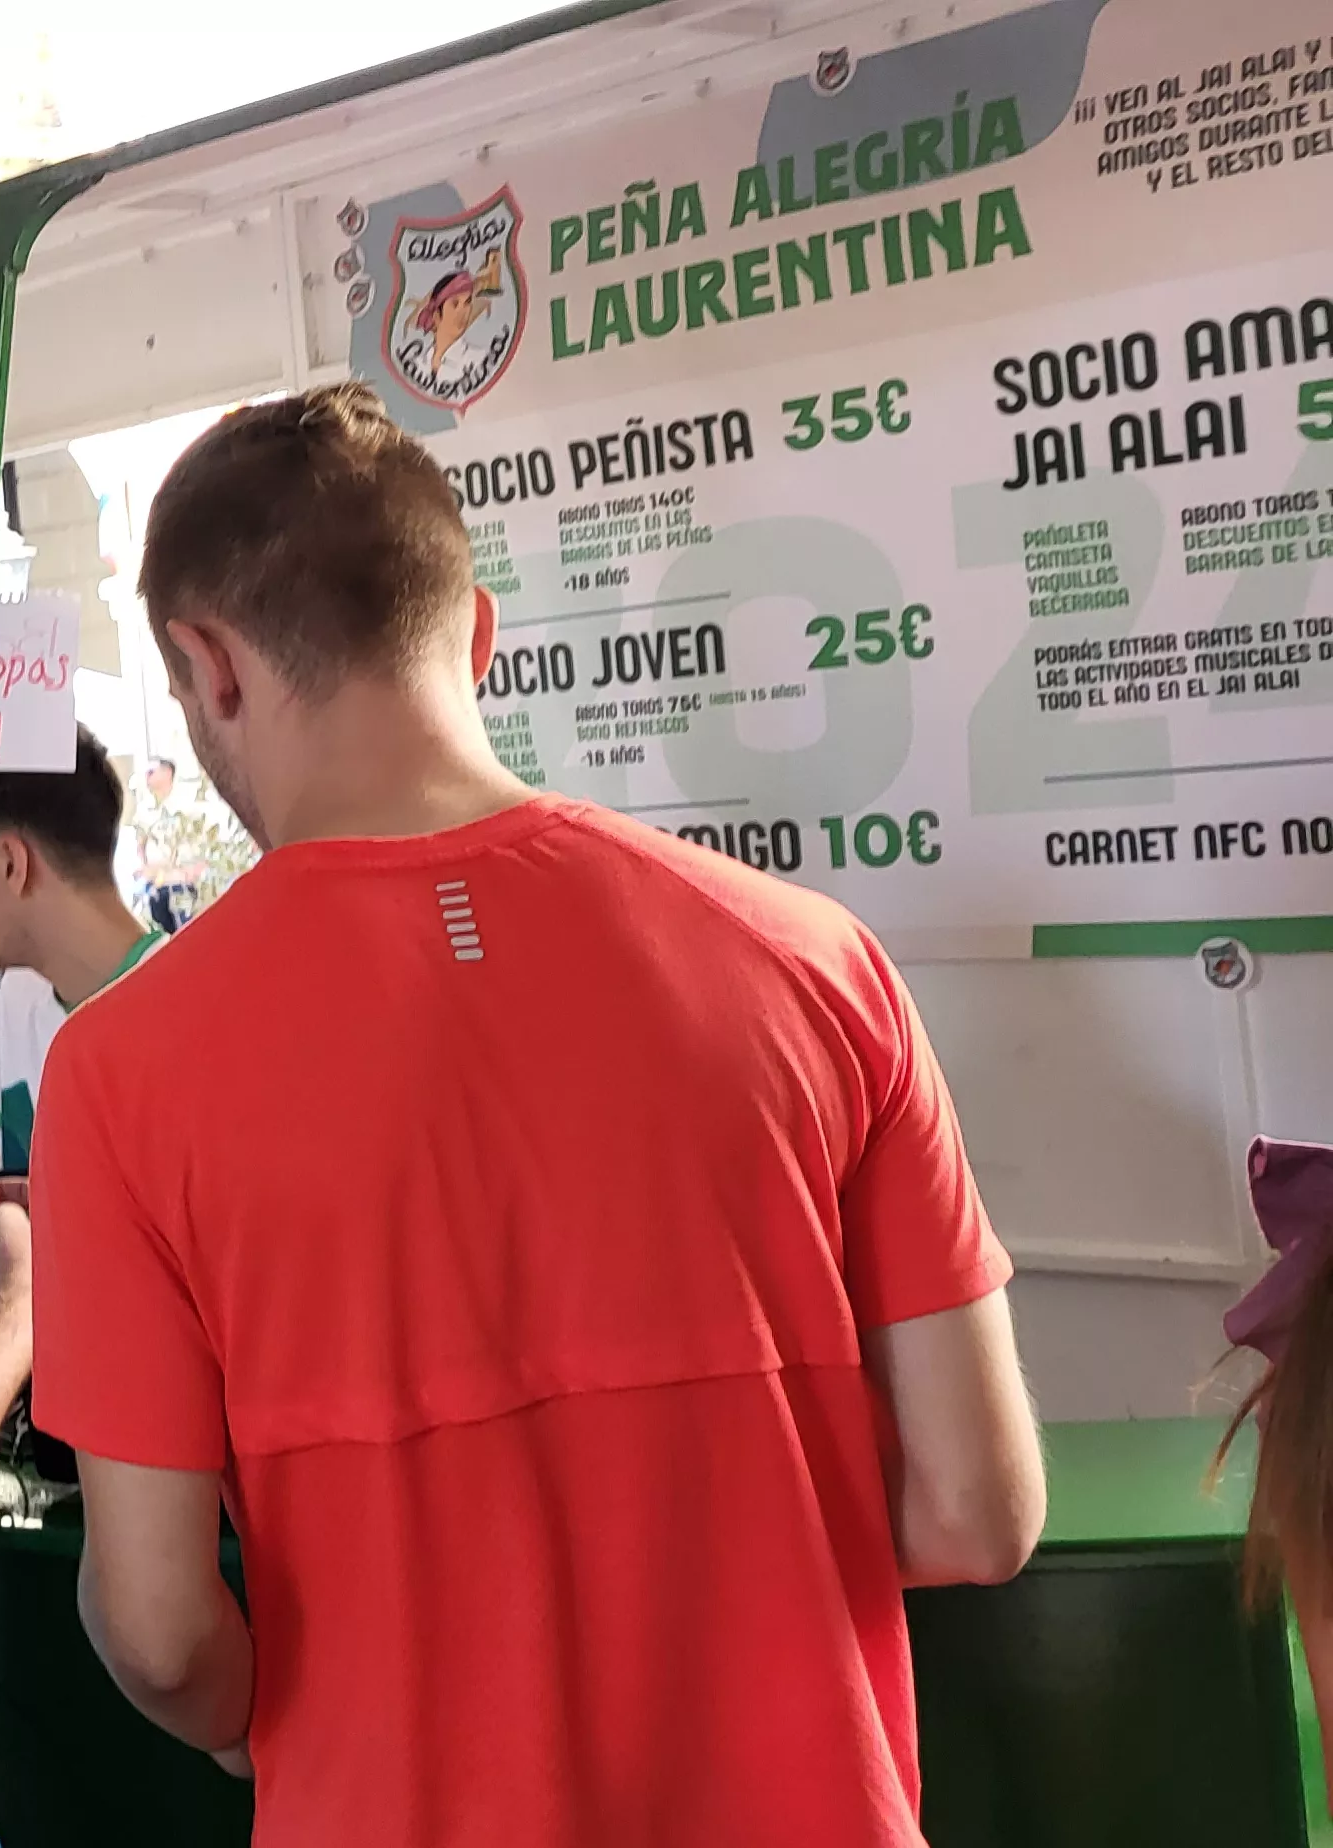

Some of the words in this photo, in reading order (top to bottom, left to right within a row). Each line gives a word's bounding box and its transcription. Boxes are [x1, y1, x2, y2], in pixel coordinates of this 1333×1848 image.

[1105, 84, 1148, 115] VEN
[1157, 75, 1186, 104] AL
[1193, 61, 1232, 94] JAI
[1241, 45, 1296, 81] ALAI
[1304, 37, 1321, 64] Y
[1097, 132, 1189, 176] AMIGOS
[1199, 103, 1311, 151] DURANTE
[1104, 107, 1177, 144] OTROS
[550, 177, 706, 275] PEÑA
[730, 90, 1025, 228] ALEGRÍA
[1146, 168, 1162, 194] Y
[1171, 162, 1199, 189] EL
[1207, 140, 1283, 180] RESTO
[550, 185, 1033, 361] LAURENTINA
[993, 332, 1158, 415] SOCIO
[443, 449, 555, 512] SOCIO
[568, 407, 754, 491] PEÑISTA
[781, 378, 912, 451] 35€
[1002, 422, 1086, 491] JAI
[1109, 394, 1248, 474] ALAI
[559, 502, 600, 525] ABONO
[605, 494, 645, 518] TOROS
[649, 486, 695, 510] 140€
[1181, 500, 1246, 528] ABONO
[1252, 490, 1319, 517] TOROS
[560, 516, 640, 545] DESCUENTOS
[666, 507, 691, 528] LAS
[638, 533, 662, 554] LAS
[1023, 519, 1109, 550] PAÑOLETA
[1183, 516, 1310, 551] DESCUENTOS
[595, 566, 629, 588] AÑOS
[1025, 543, 1112, 573] CAMISETA
[1186, 546, 1264, 576] BARRAS
[1273, 542, 1298, 564] DE
[1027, 565, 1119, 595] VAQUILLAS
[1029, 587, 1130, 618] BECERRADA
[476, 642, 574, 700] OCIO
[592, 623, 726, 688] JOVEN
[805, 604, 935, 671] 25€
[1034, 638, 1103, 667] PODRÁS
[1109, 633, 1177, 659] ENTRAR
[1185, 624, 1253, 650] GRATIS
[1260, 621, 1286, 642] EN
[1037, 668, 1068, 690] LAS
[1075, 655, 1188, 685] ACTIVIDADES
[1194, 642, 1311, 673] MUSICALES
[1038, 690, 1081, 712] TODO
[1088, 688, 1108, 708] EL
[1114, 682, 1151, 705] AÑO
[1157, 679, 1180, 702] EN
[1187, 677, 1209, 699] EL
[1216, 673, 1246, 695] JAI
[1254, 668, 1300, 691] ALAI
[576, 700, 617, 722] ABONO
[623, 698, 664, 717] TOROS
[615, 716, 689, 738] REFRESCOS
[611, 745, 645, 764] AÑOS
[655, 818, 802, 871] MIGO
[820, 810, 942, 869] 10€
[1045, 825, 1179, 866] CARNET
[1194, 820, 1267, 861] NFC
